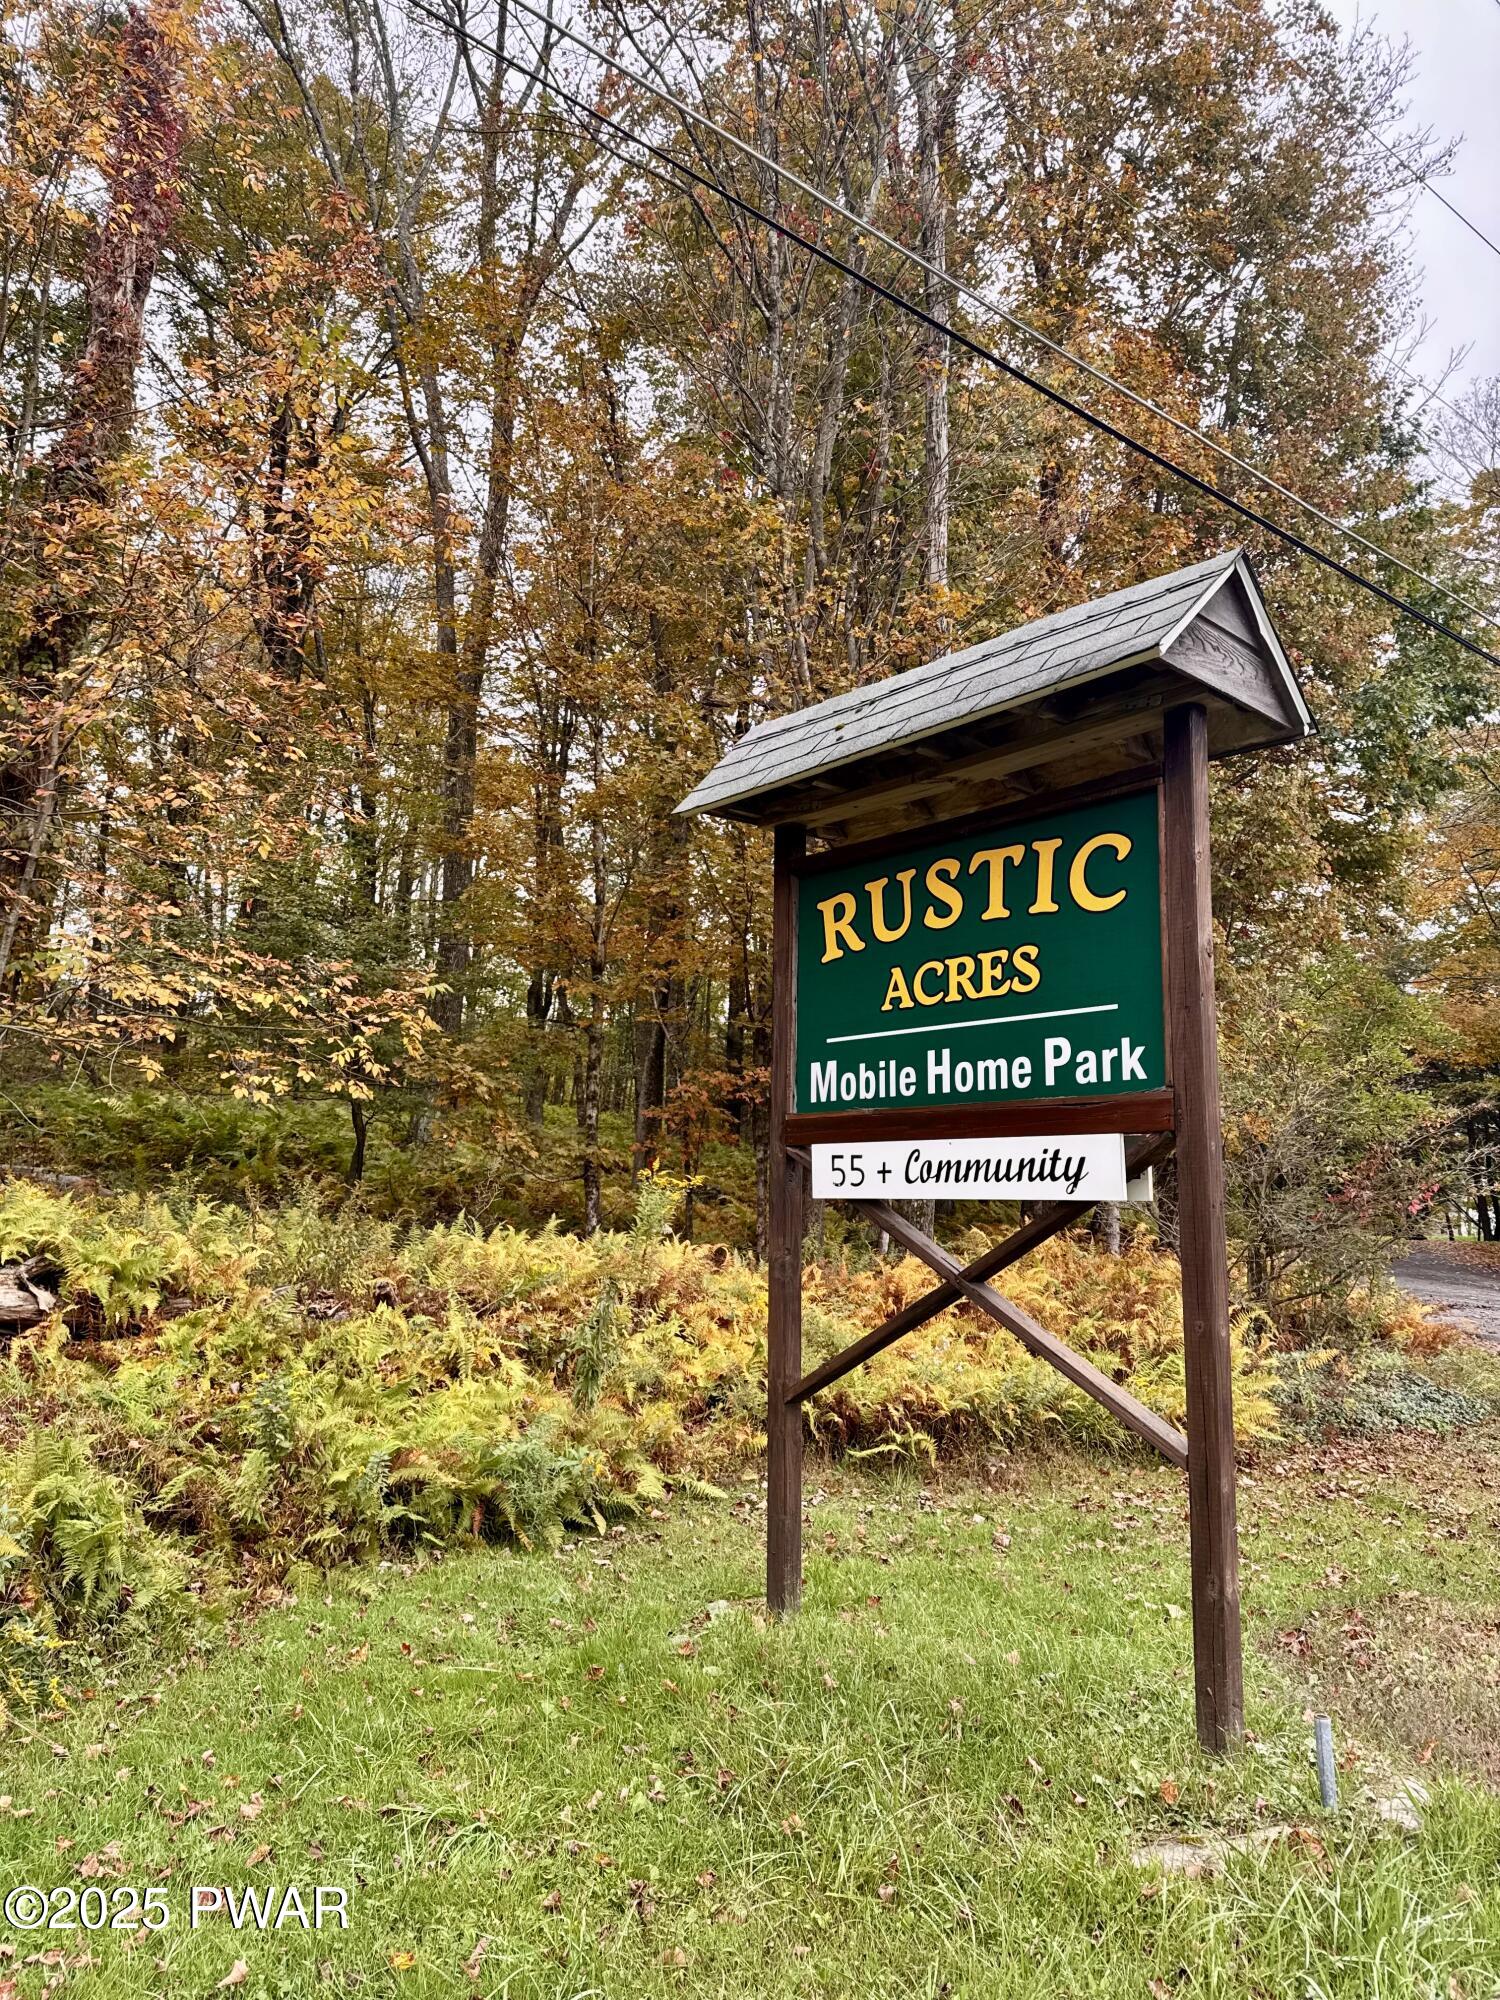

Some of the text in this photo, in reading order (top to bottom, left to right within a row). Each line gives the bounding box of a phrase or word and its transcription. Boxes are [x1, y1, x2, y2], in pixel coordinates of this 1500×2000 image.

[816, 833, 1133, 963] RUSTIC
[880, 945, 1041, 1011] ACRES
[810, 1036, 1148, 1103] Mobile Home Park
[904, 1148, 1089, 1194] Community
